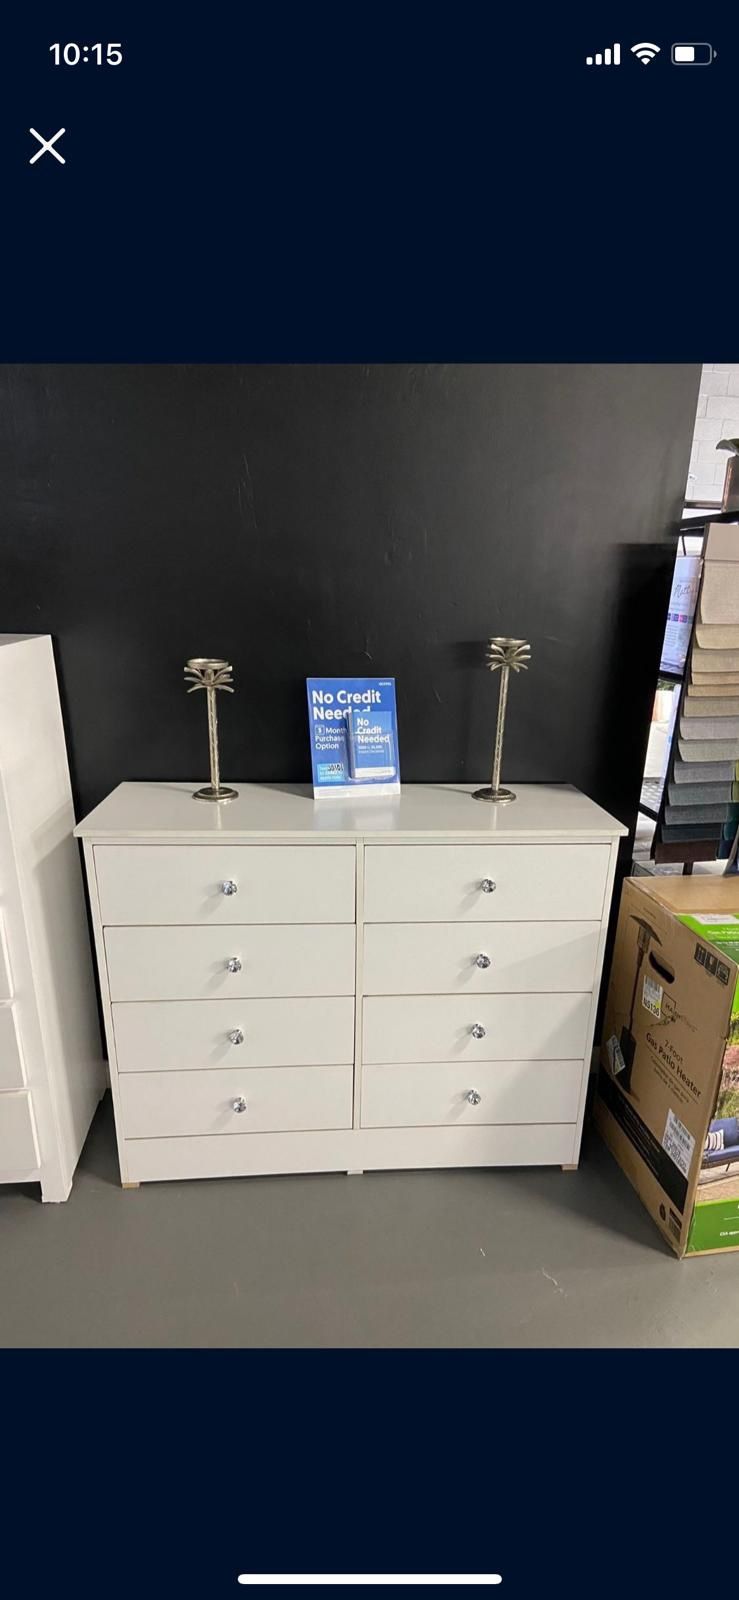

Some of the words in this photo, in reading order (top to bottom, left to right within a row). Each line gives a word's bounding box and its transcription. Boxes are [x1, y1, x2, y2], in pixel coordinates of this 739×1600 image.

[312, 690, 333, 704] No
[337, 689, 381, 704] Credit
[313, 706, 370, 720] Need
[357, 718, 369, 727] No
[358, 734, 390, 744] Needed
[646, 1032, 658, 1050] Gas
[658, 1045, 676, 1070] Patio
[676, 1065, 702, 1097] Heater
